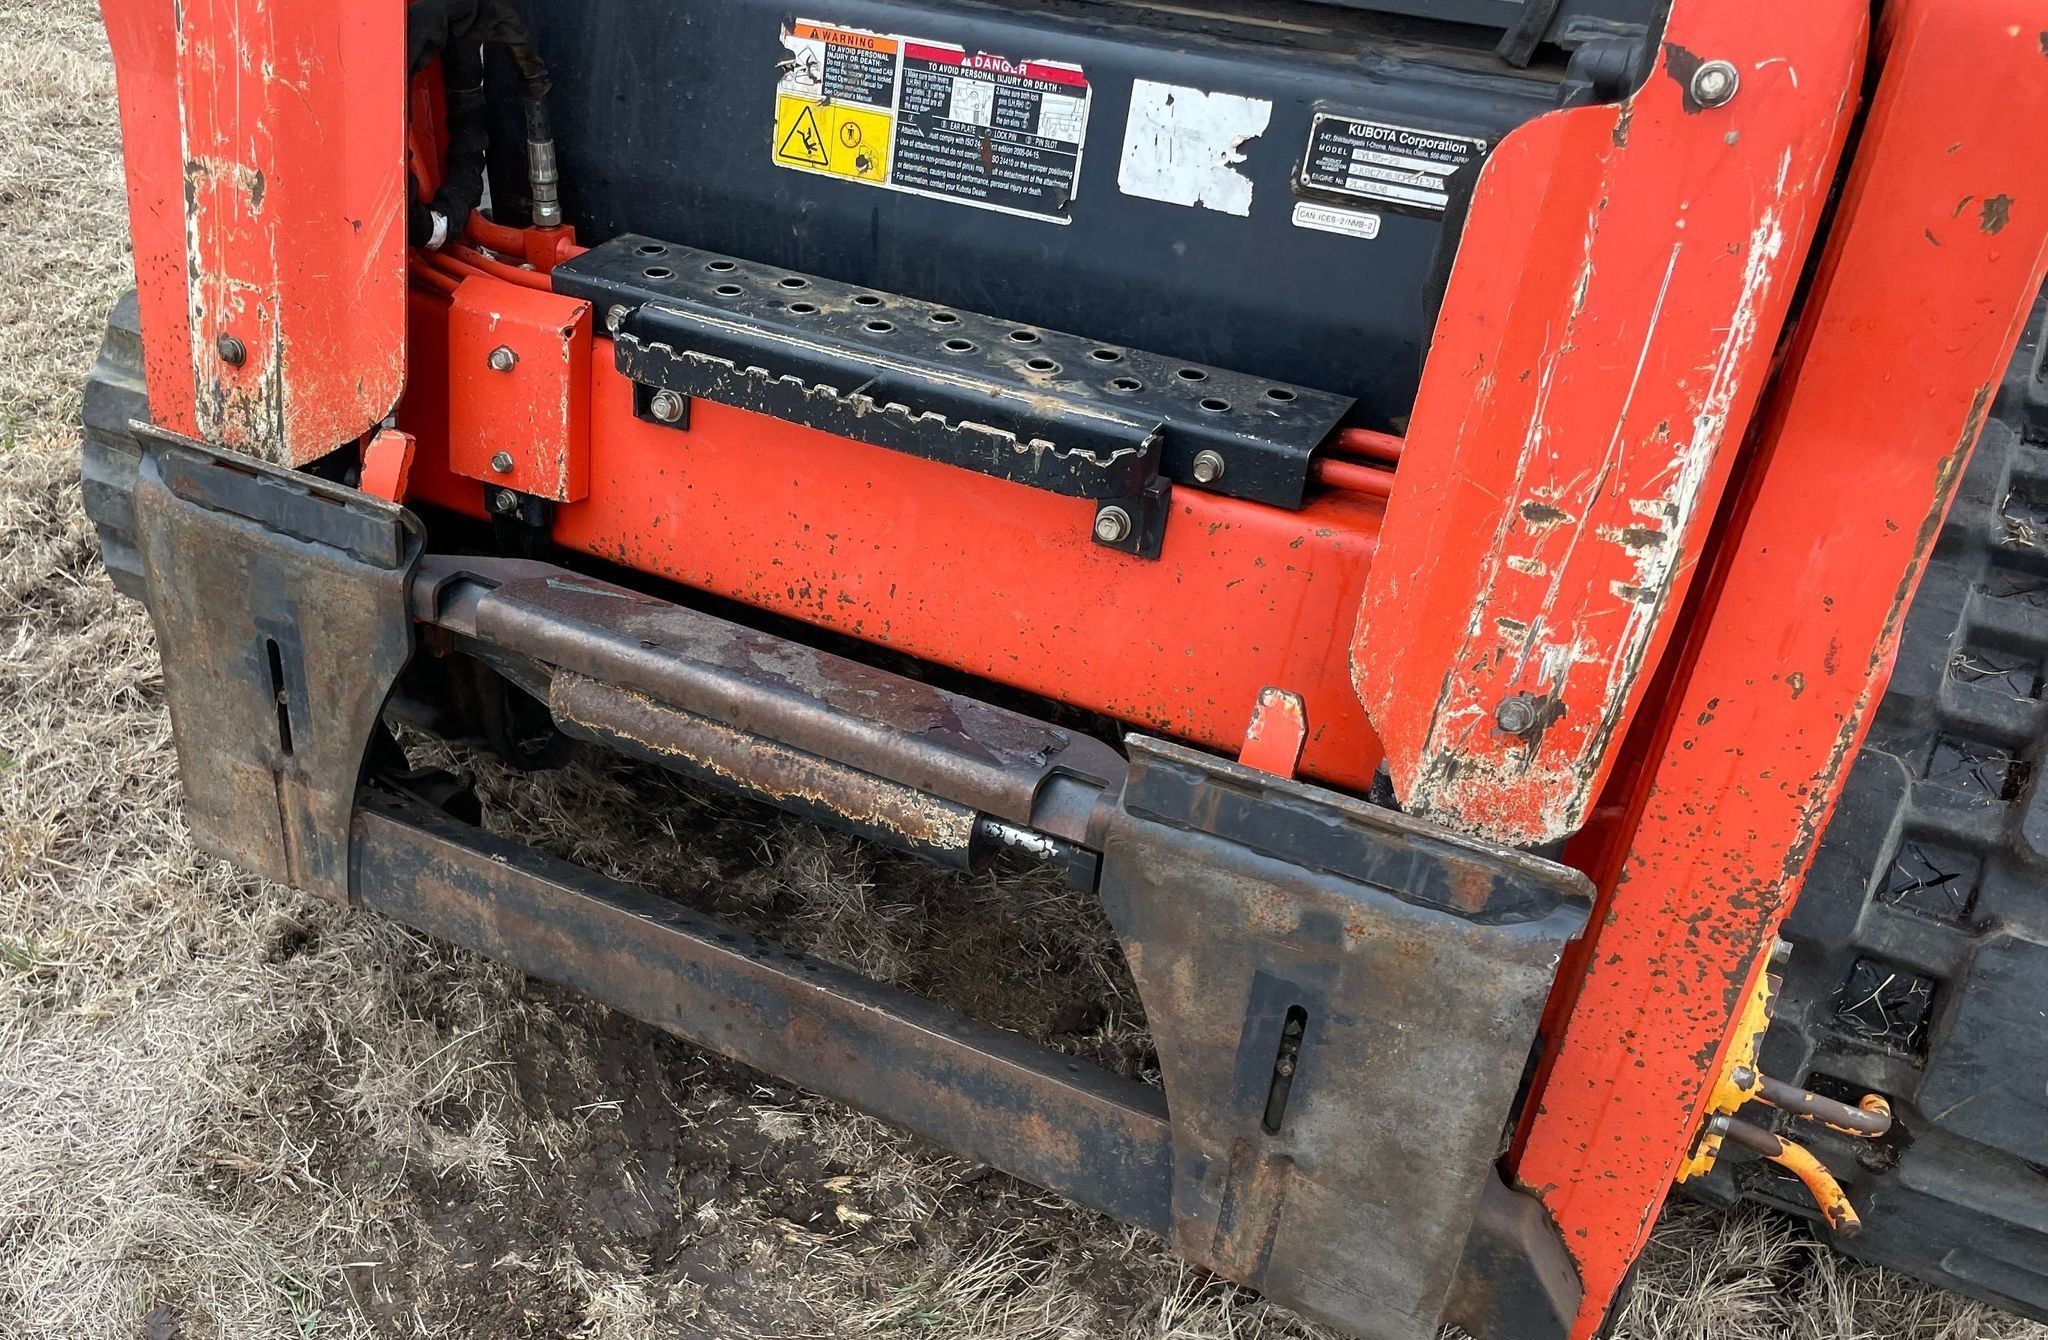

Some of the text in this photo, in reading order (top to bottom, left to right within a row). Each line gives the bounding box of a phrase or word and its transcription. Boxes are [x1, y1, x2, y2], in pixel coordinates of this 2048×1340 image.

[822, 31, 874, 48] WARNING
[827, 51, 848, 60] INJURY
[837, 46, 856, 54] AVOID
[857, 49, 890, 60] PERSONAL
[928, 62, 937, 71] TO
[939, 64, 959, 75] AVOID
[961, 68, 996, 82] PERSONAL
[997, 74, 1020, 86] INJURY
[1023, 79, 1033, 87] OR
[1034, 80, 1057, 92] DEATH
[950, 122, 961, 131] EAR
[961, 124, 976, 134] PLATE
[994, 130, 1008, 139] LOCK
[1008, 133, 1016, 141] PIN
[939, 134, 954, 144] comply
[964, 138, 974, 146] ISO
[998, 144, 1013, 154] edition
[1035, 138, 1044, 146] PIN
[1045, 139, 1057, 149] SLOT
[1348, 124, 1468, 155] KUBOTA Corporation
[914, 141, 940, 152] attachments
[1027, 162, 1048, 174] improper
[1318, 144, 1348, 155] MODEL
[896, 172, 904, 180] For
[929, 180, 945, 188] contact
[945, 183, 955, 192] your
[956, 184, 971, 193] Kubota
[1003, 170, 1029, 181] detachment
[1035, 176, 1043, 184] the
[1043, 178, 1069, 189] attachment
[1311, 173, 1334, 182] ENGINE
[1300, 210, 1373, 229] CAN ICES-2/NMB-2
